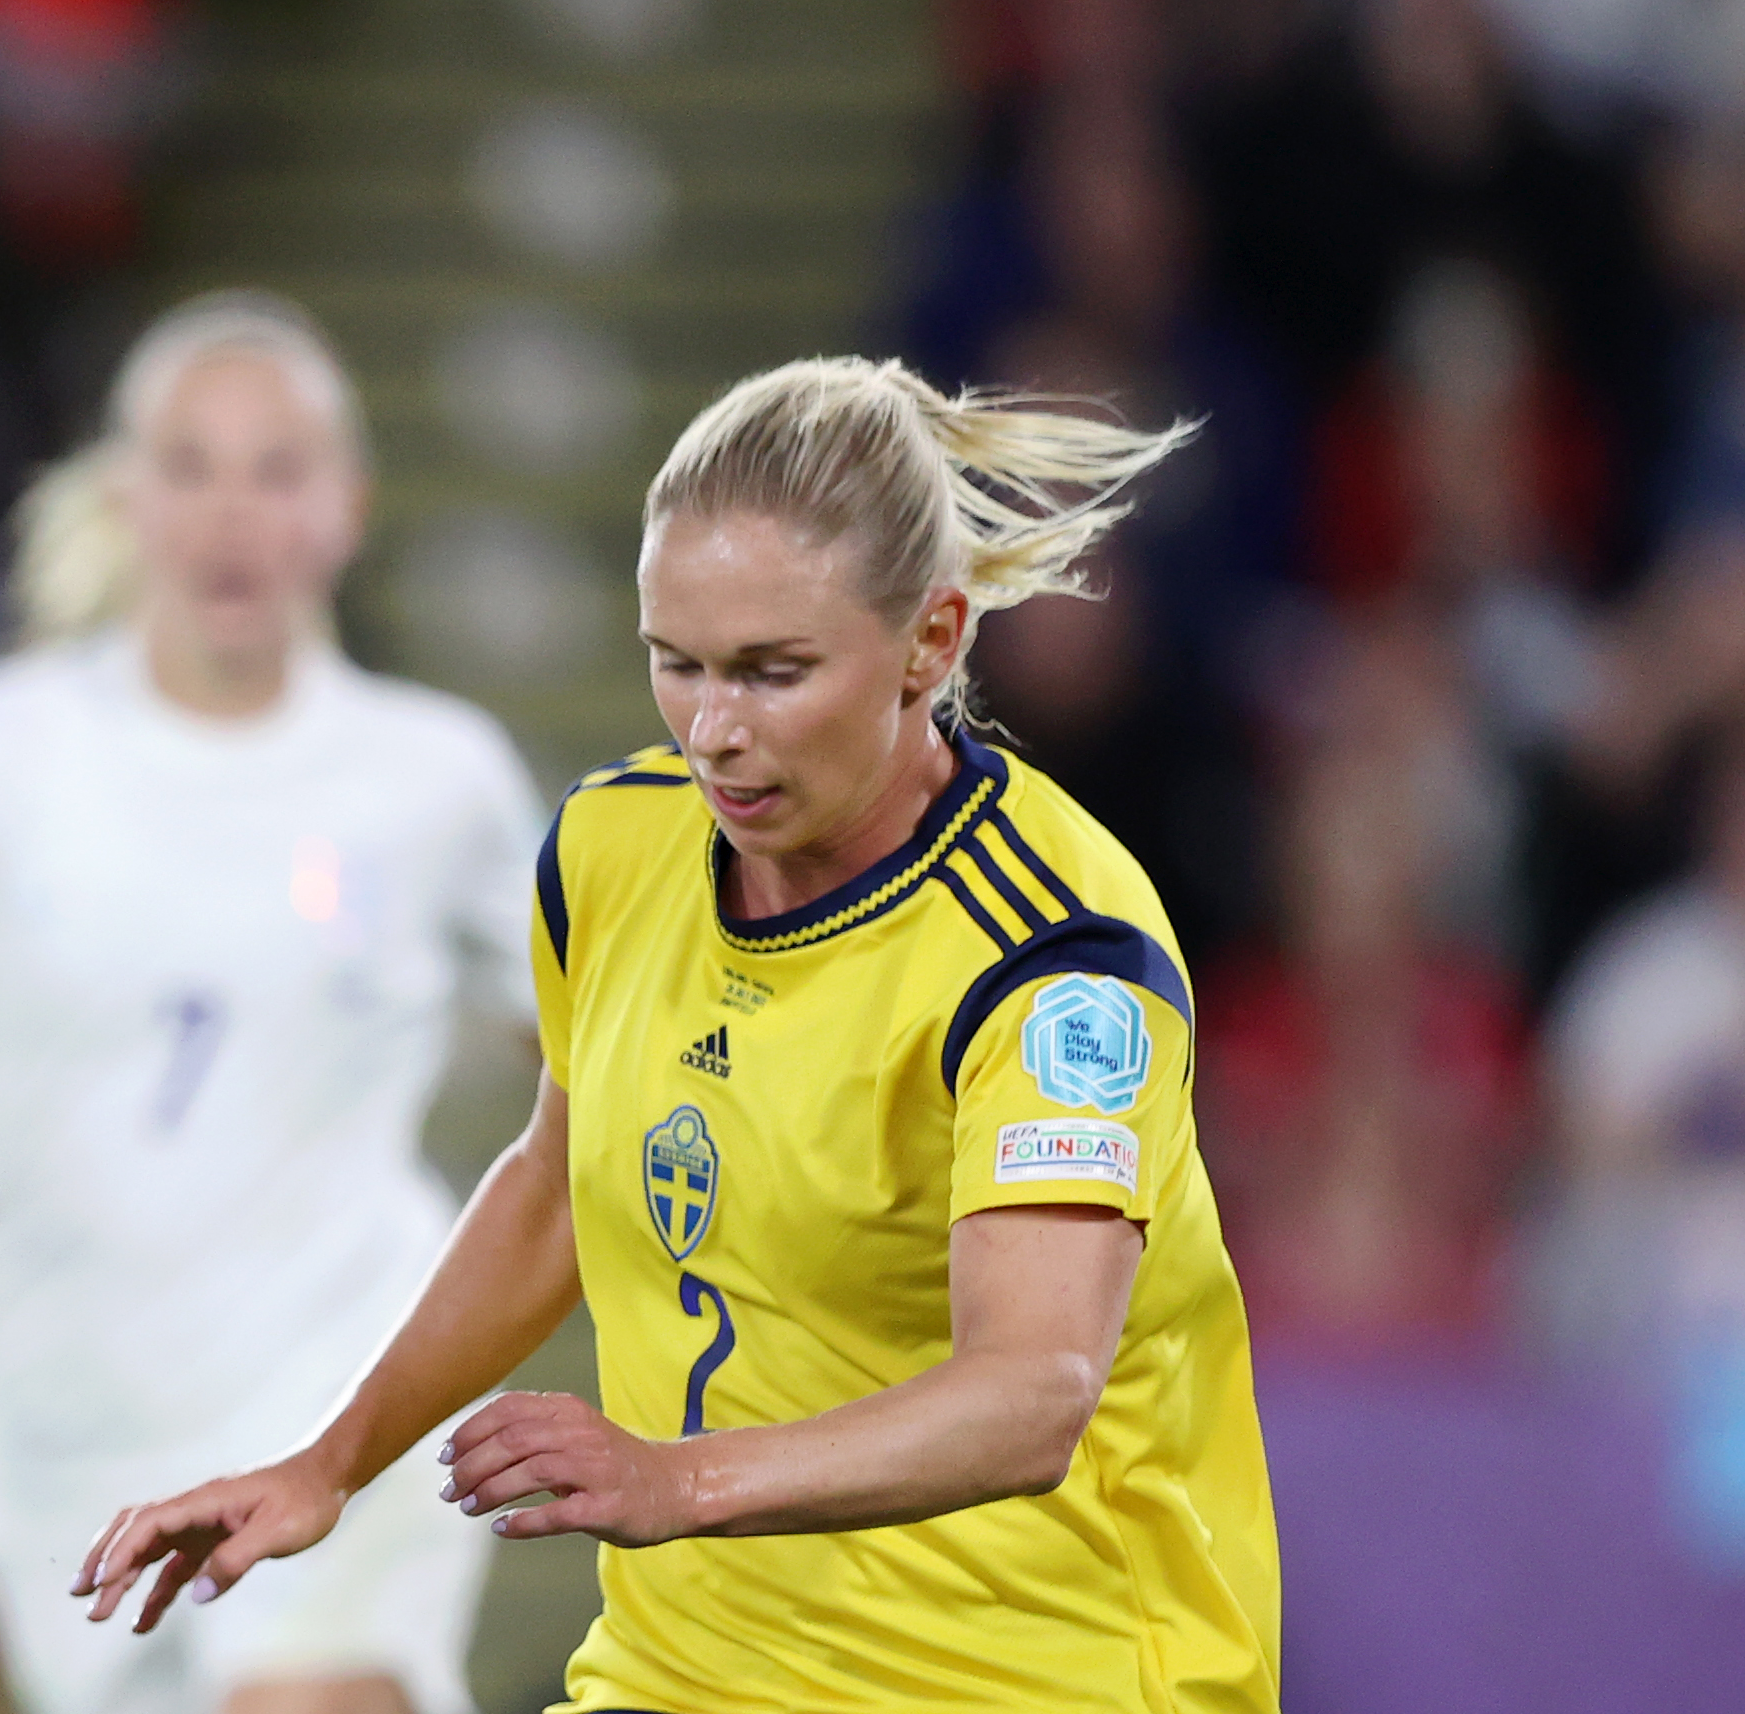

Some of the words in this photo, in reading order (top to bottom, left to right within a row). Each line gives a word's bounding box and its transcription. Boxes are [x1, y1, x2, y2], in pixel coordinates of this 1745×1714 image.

[1064, 1019, 1090, 1033] We
[679, 1050, 732, 1080] adidas
[1064, 1048, 1119, 1073] Strong
[1002, 1126, 1038, 1142] UEFA
[679, 1271, 736, 1438] 2
